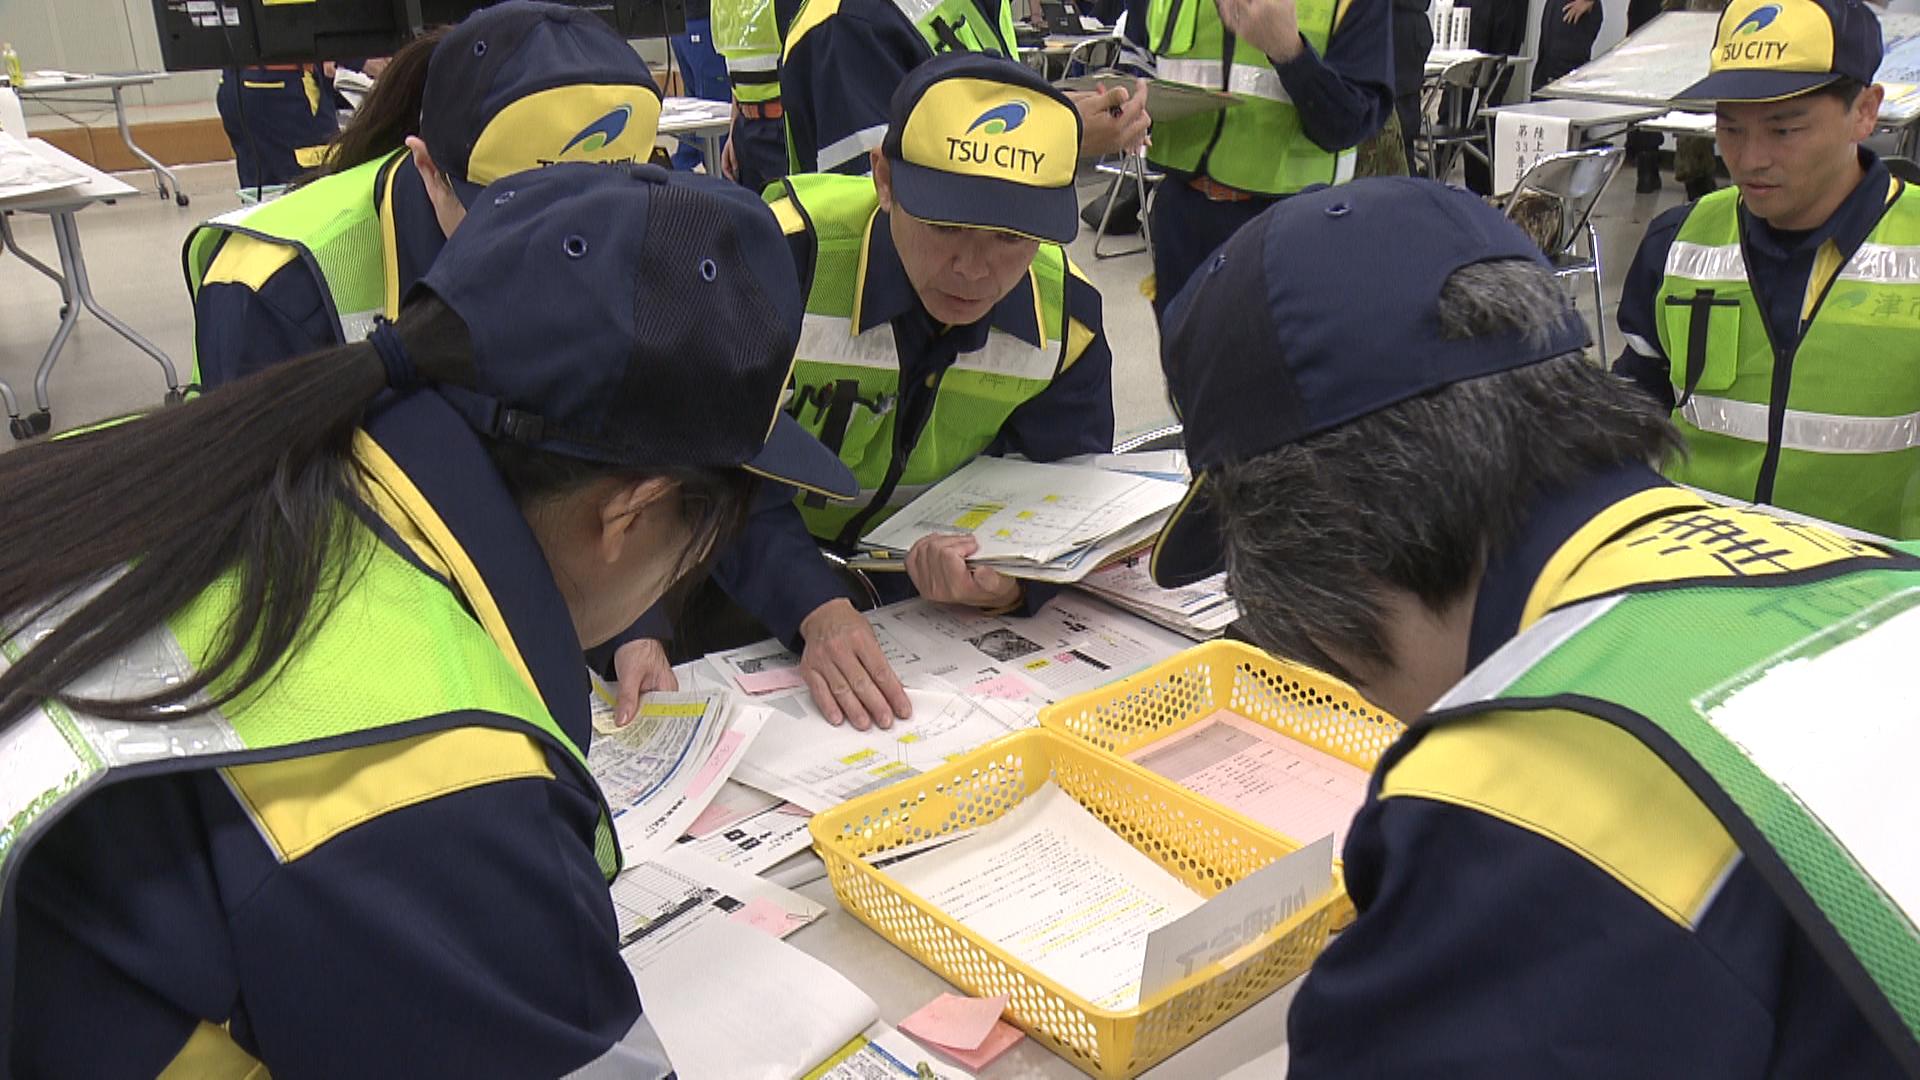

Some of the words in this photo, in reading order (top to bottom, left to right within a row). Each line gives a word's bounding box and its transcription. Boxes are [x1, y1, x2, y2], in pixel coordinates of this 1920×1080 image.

[1745, 41, 1788, 60] CITY
[946, 137, 989, 164] TSU
[994, 145, 1046, 174] CITY
